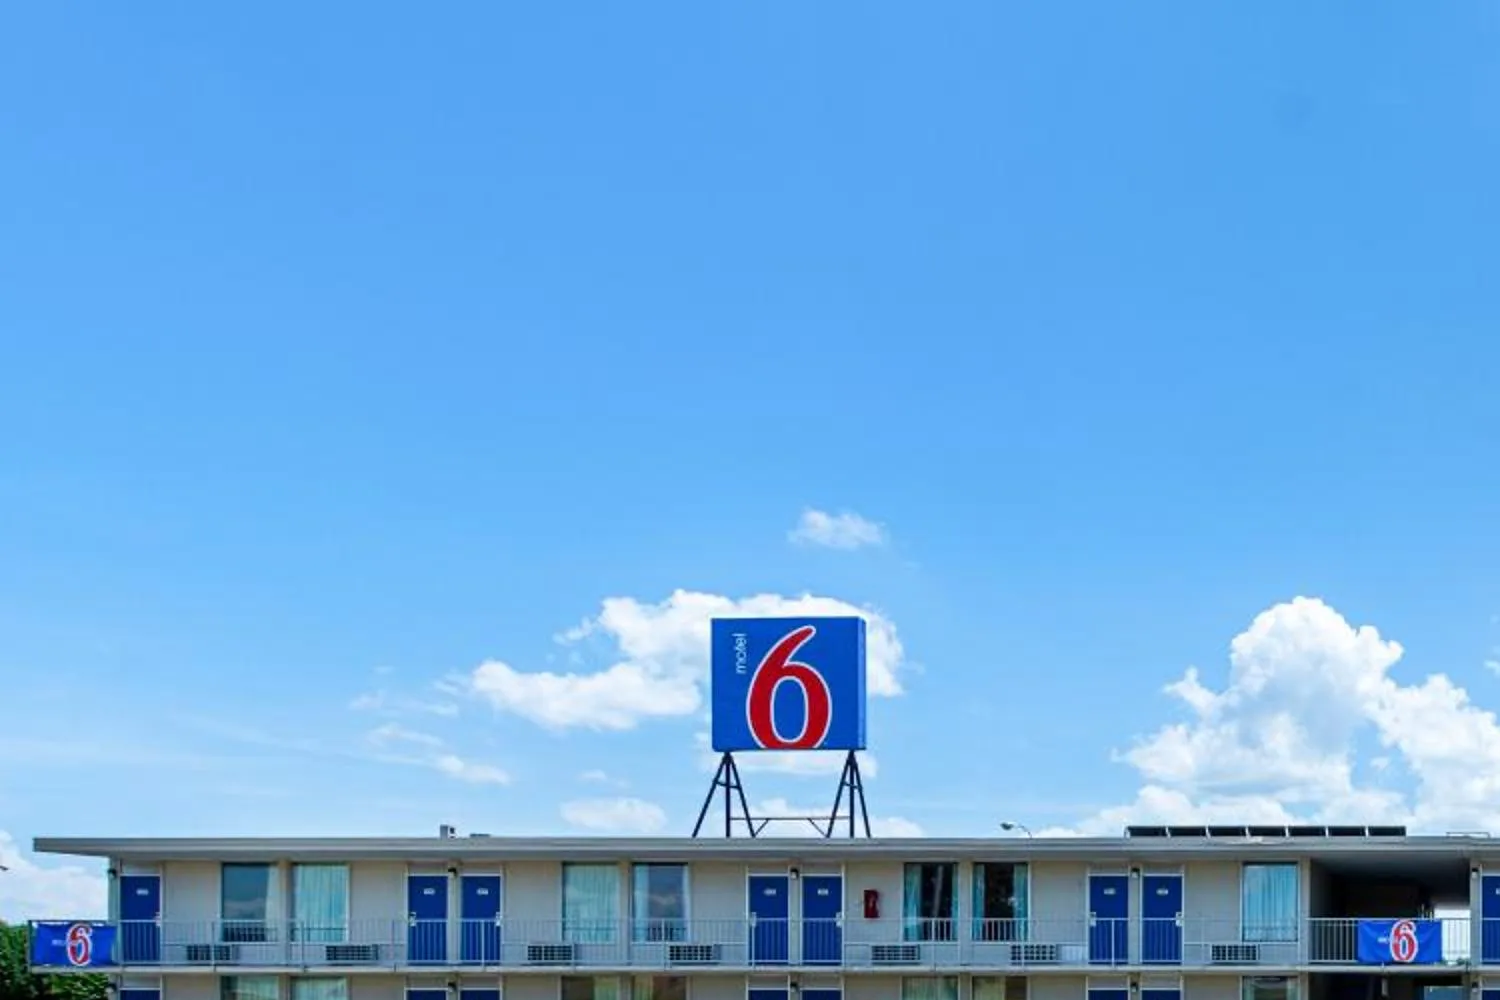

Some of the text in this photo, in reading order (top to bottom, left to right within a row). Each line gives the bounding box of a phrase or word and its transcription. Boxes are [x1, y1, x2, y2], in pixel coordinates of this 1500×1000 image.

[746, 625, 832, 748] 6
[66, 923, 93, 967] 6
[1390, 919, 1418, 963] 6
